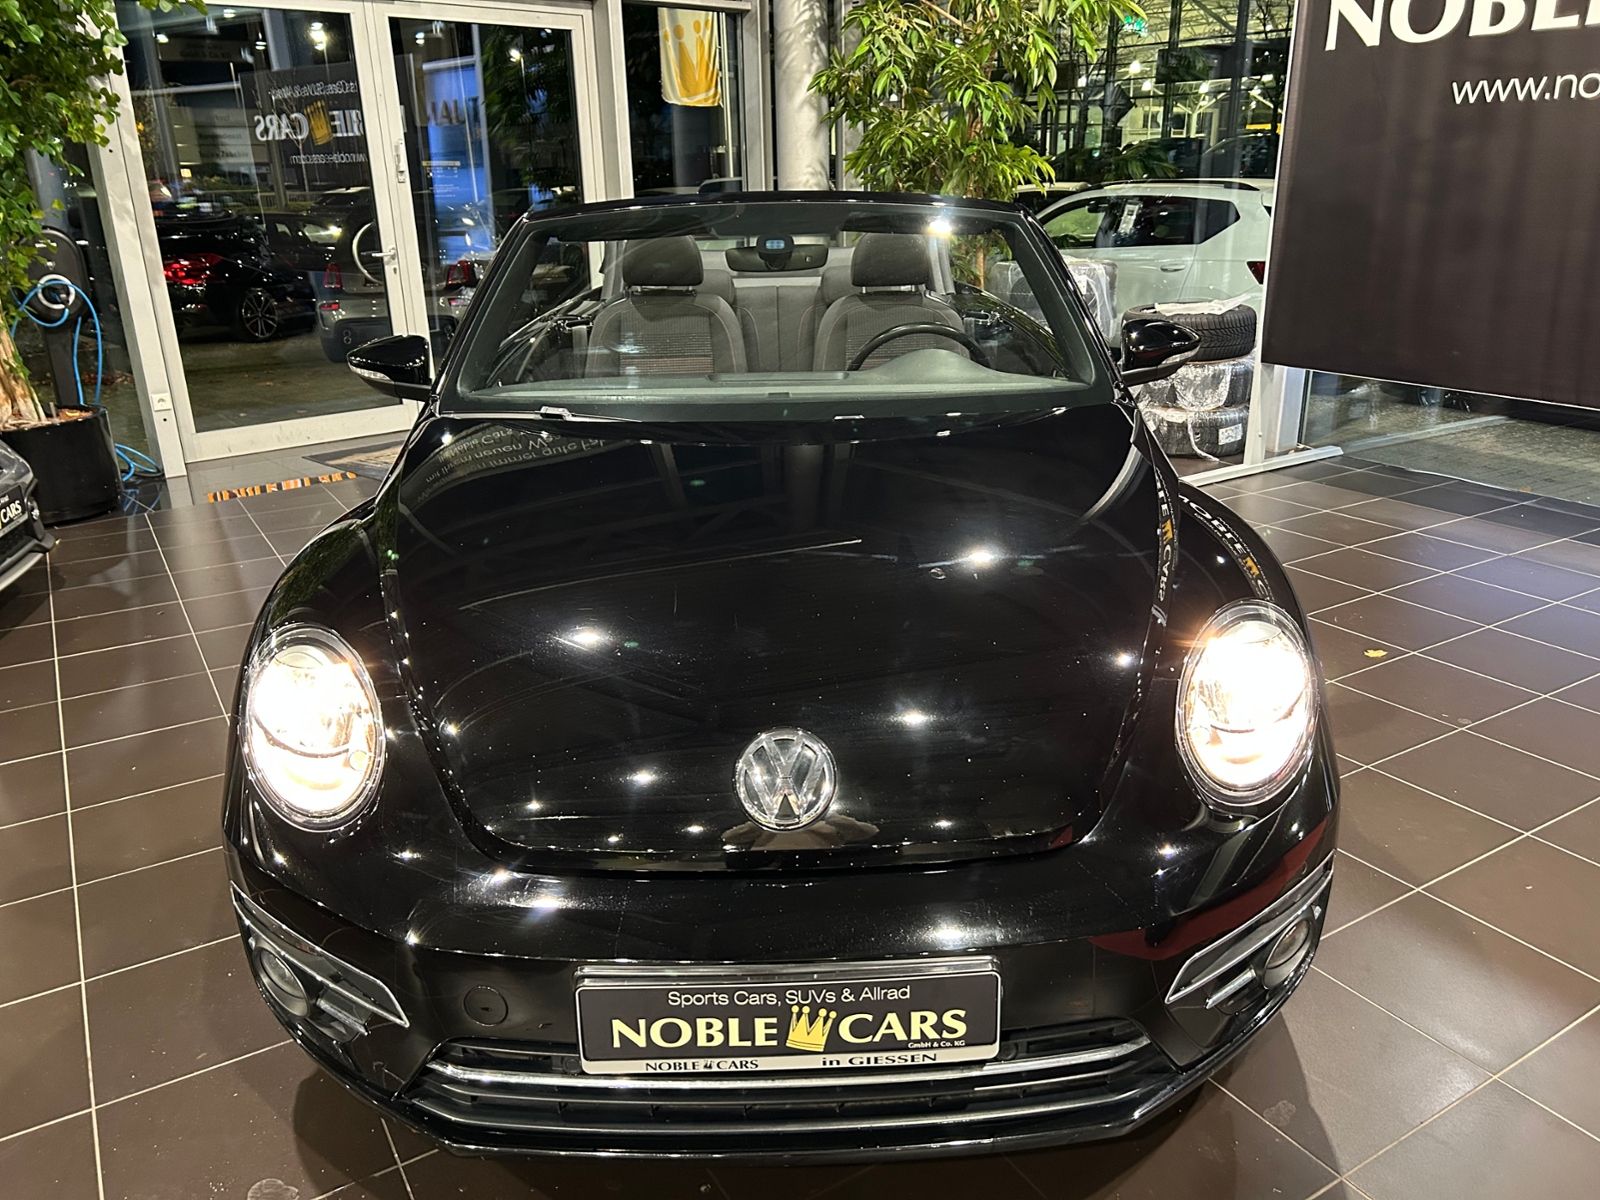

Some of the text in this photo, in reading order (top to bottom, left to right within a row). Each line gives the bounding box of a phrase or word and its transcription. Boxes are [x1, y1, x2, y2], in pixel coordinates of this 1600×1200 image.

[668, 985, 910, 1008] Sports Cars, SUVs & Allrad
[611, 1009, 967, 1049] NOBLE CARS
[908, 1041, 932, 1049] GmbH
[645, 1059, 759, 1071] NOBLE CARS
[821, 1053, 937, 1067] in GIESSEN
